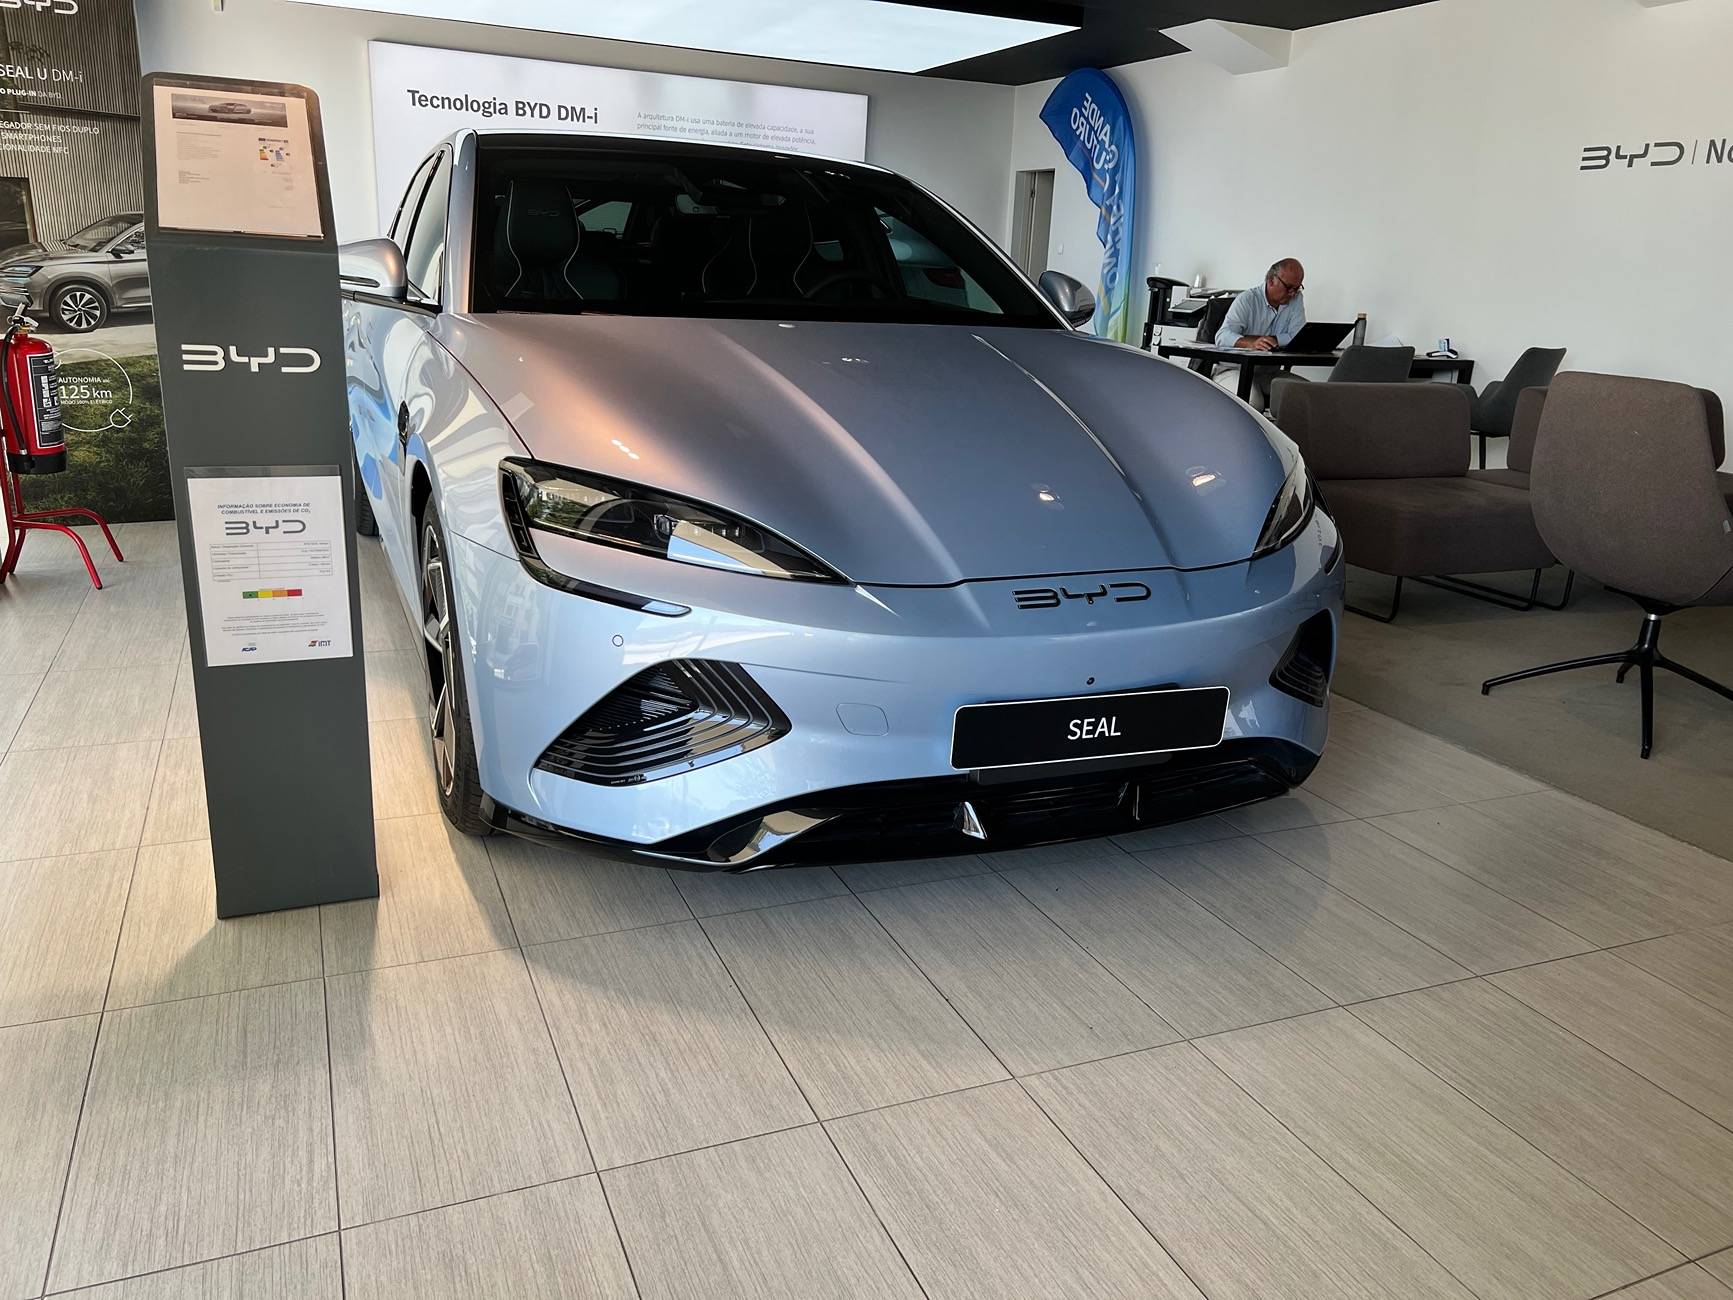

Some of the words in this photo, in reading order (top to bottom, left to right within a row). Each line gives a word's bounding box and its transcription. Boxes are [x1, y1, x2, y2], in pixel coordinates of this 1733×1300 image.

[0, 63, 34, 80] SEAL
[36, 67, 48, 81] U
[52, 68, 83, 83] DM-i
[7, 88, 37, 98] PLUG-IN
[406, 88, 509, 118] Tecnologia
[514, 100, 551, 120] BYD
[557, 104, 598, 125] DM-i
[34, 122, 51, 132] SEM
[52, 124, 71, 133] FIOS
[72, 125, 100, 135] DUPLO
[1579, 140, 1685, 171] BYD
[181, 343, 321, 373] BYD
[58, 376, 102, 384] AUTONOMIA
[59, 385, 91, 399] 125
[92, 387, 113, 399] km
[224, 519, 307, 536] BYD
[1011, 581, 1152, 610] BYD
[1067, 716, 1122, 740] SEAL
